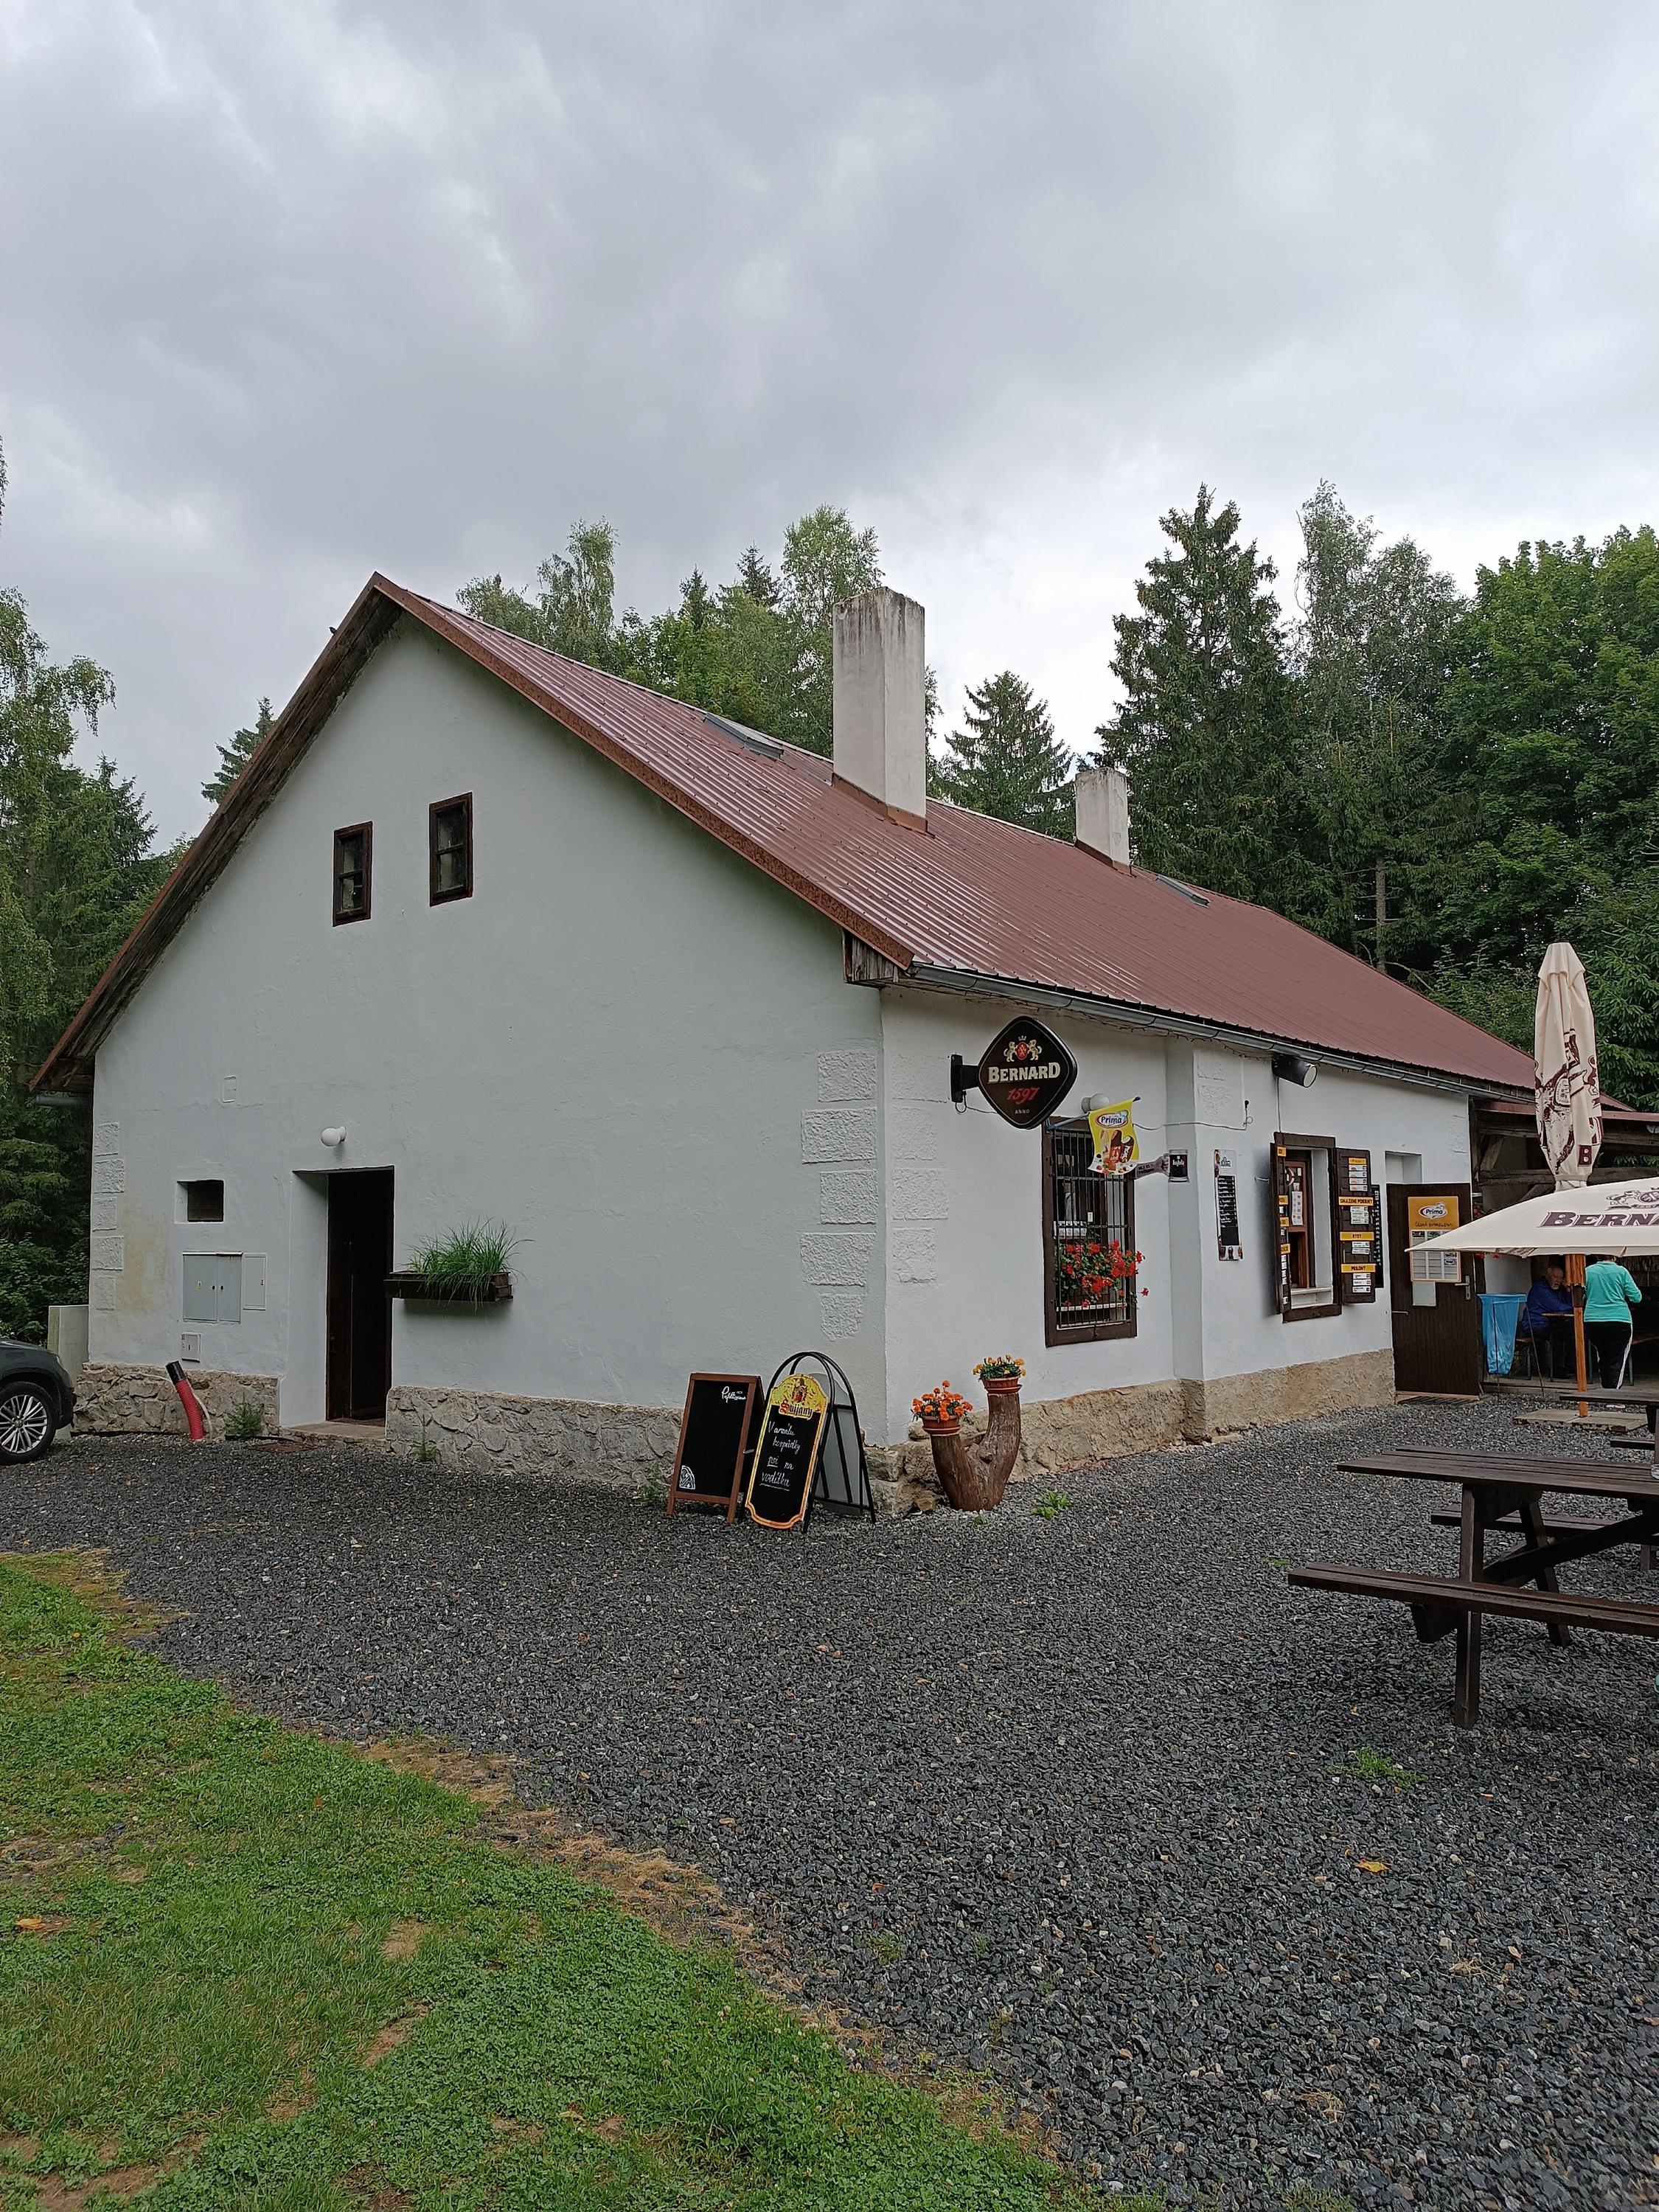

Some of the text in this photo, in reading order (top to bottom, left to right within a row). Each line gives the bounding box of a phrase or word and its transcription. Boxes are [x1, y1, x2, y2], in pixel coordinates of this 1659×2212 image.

[987, 1062, 1060, 1083] BERNARD
[1007, 1088, 1040, 1105] 1597
[1101, 1116, 1122, 1125] Prima
[779, 1399, 813, 1416] Svijany
